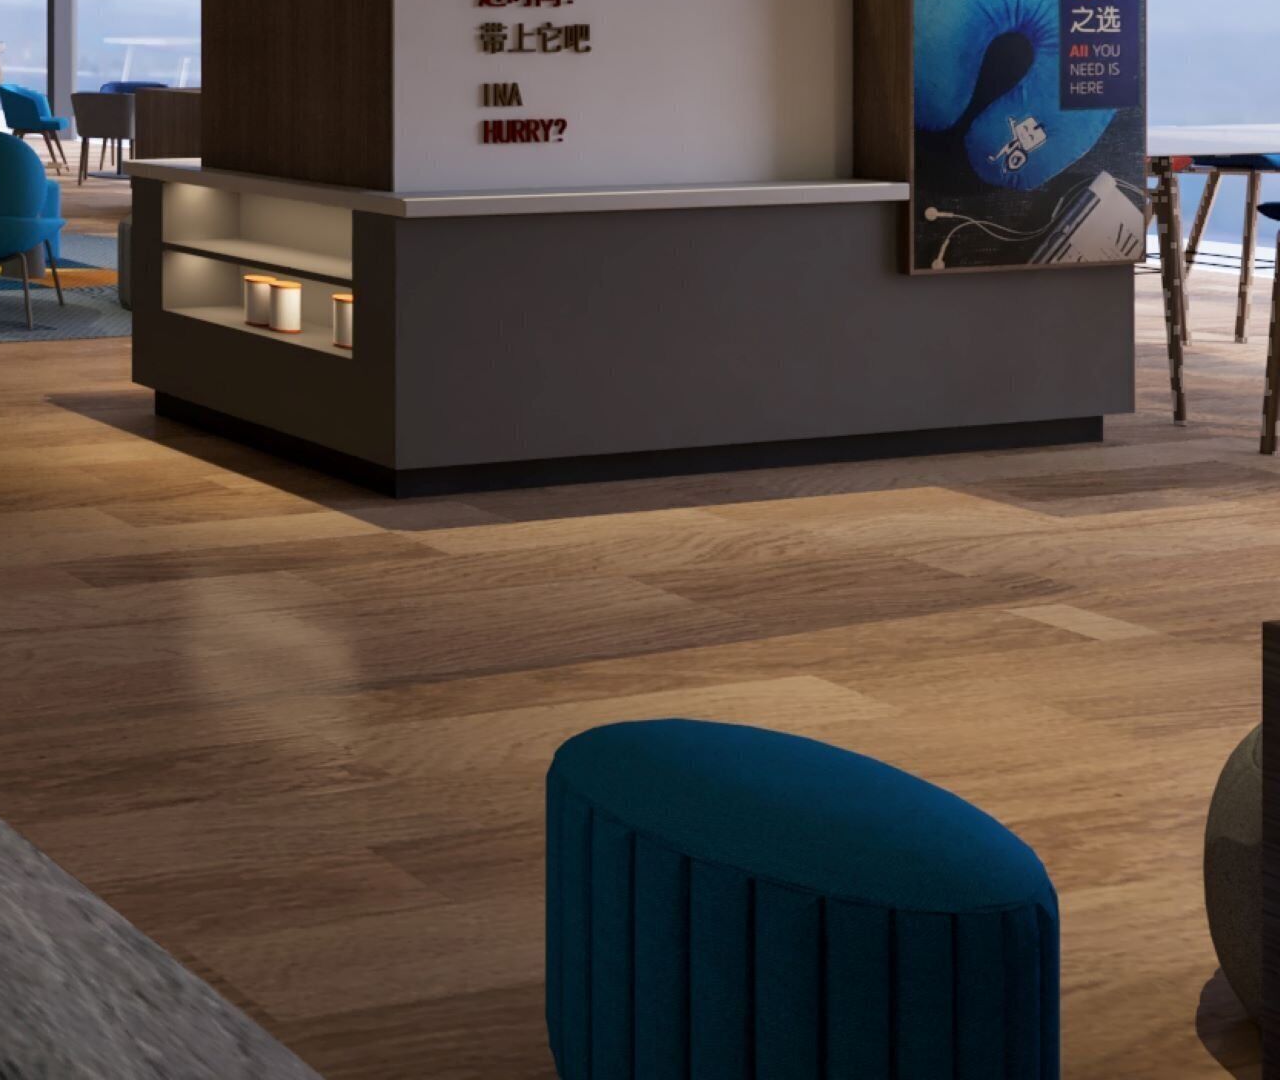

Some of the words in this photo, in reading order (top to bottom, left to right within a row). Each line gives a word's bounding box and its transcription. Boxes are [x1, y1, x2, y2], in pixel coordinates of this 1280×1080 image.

[1070, 6, 1122, 33] 之选
[479, 22, 592, 54] 带上它吧
[1092, 44, 1121, 58] YOU
[1070, 62, 1105, 76] NEED
[1108, 62, 1121, 76] IS
[1070, 81, 1104, 94] HERE
[481, 118, 568, 144] HURRY?
